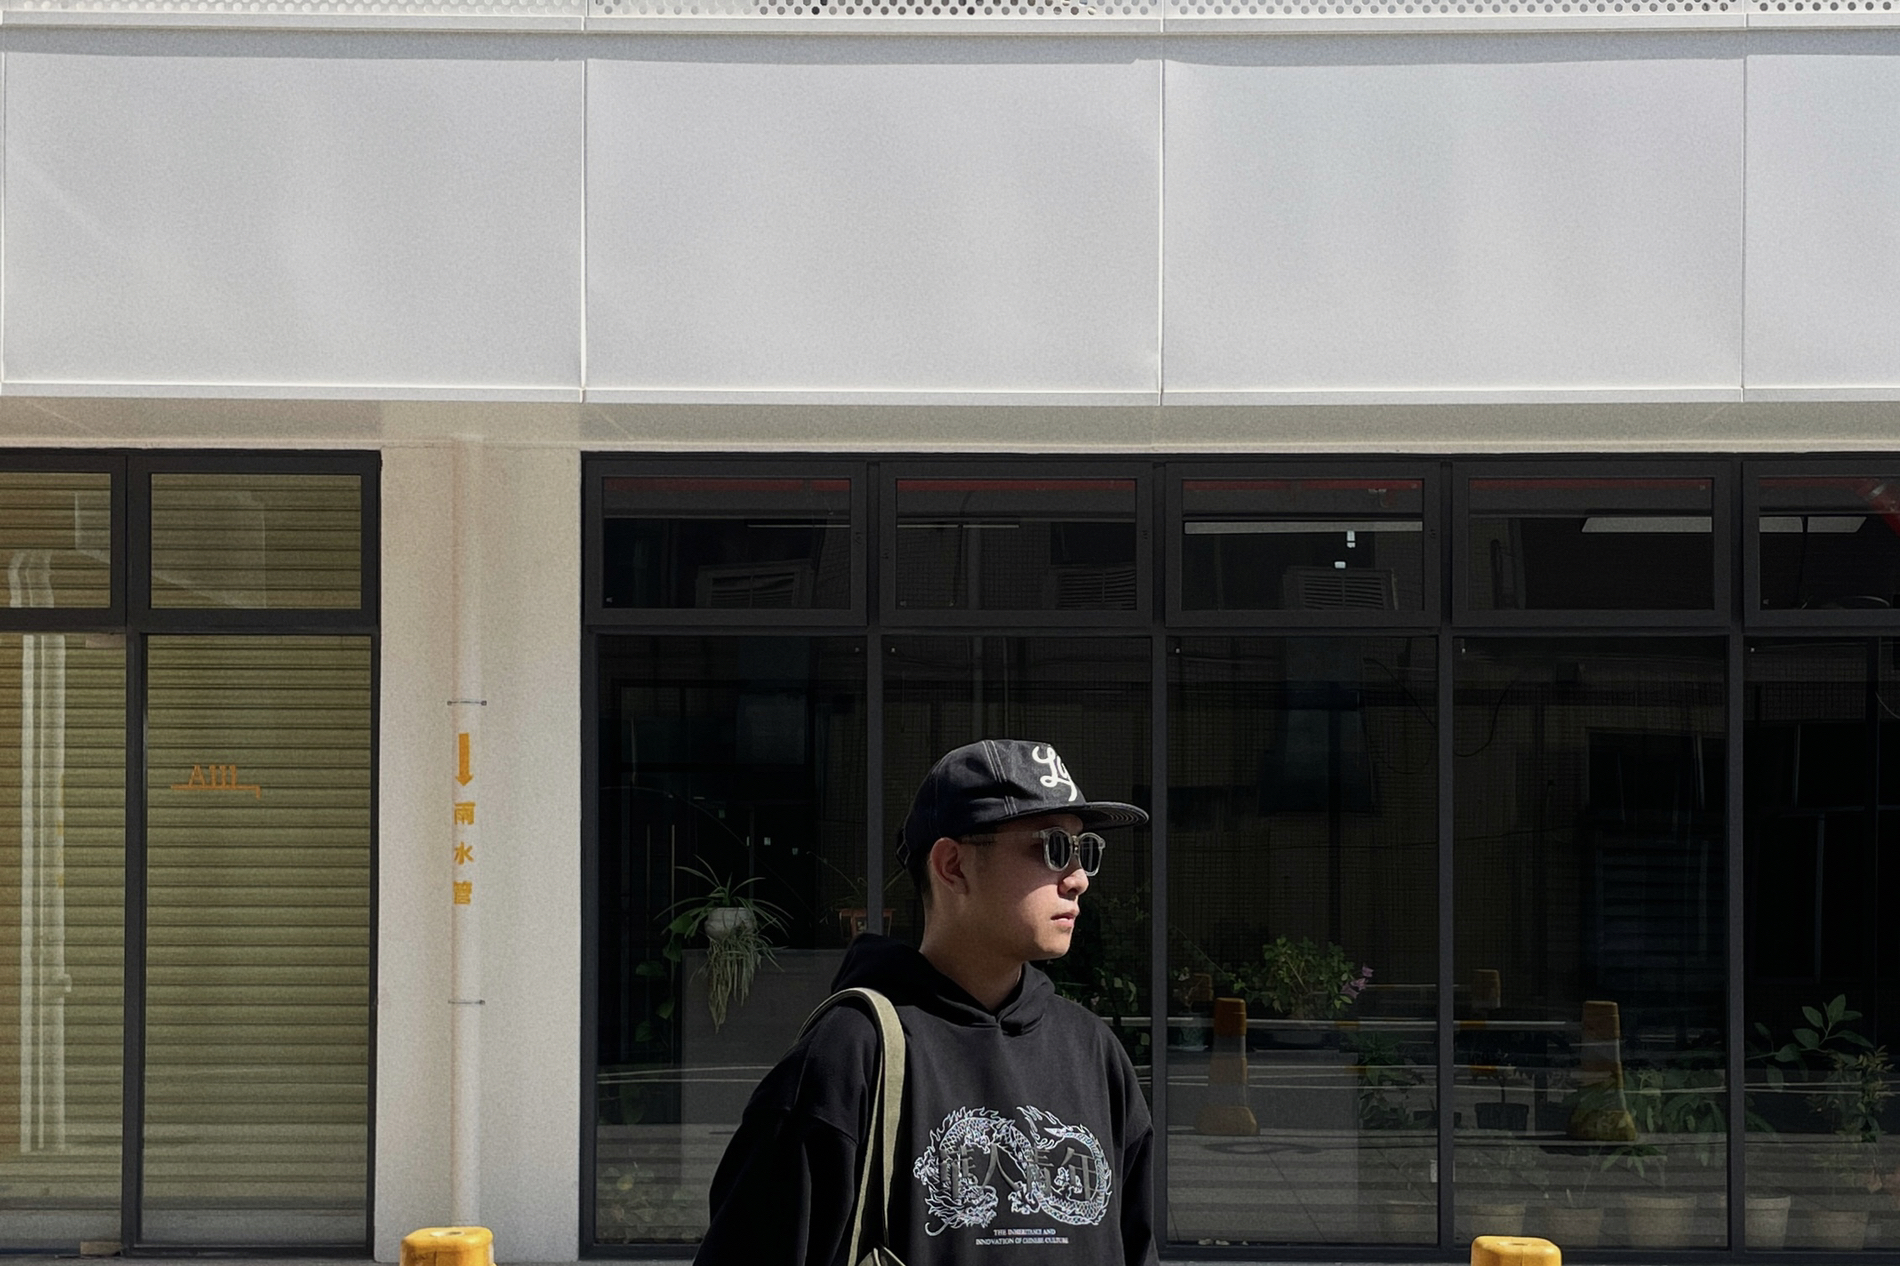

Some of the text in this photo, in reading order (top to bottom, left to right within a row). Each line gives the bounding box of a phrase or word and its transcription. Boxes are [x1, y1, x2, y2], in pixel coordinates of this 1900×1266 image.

[453, 802, 476, 906] 雨水管
[975, 1238, 1014, 1246] INNOVATION
